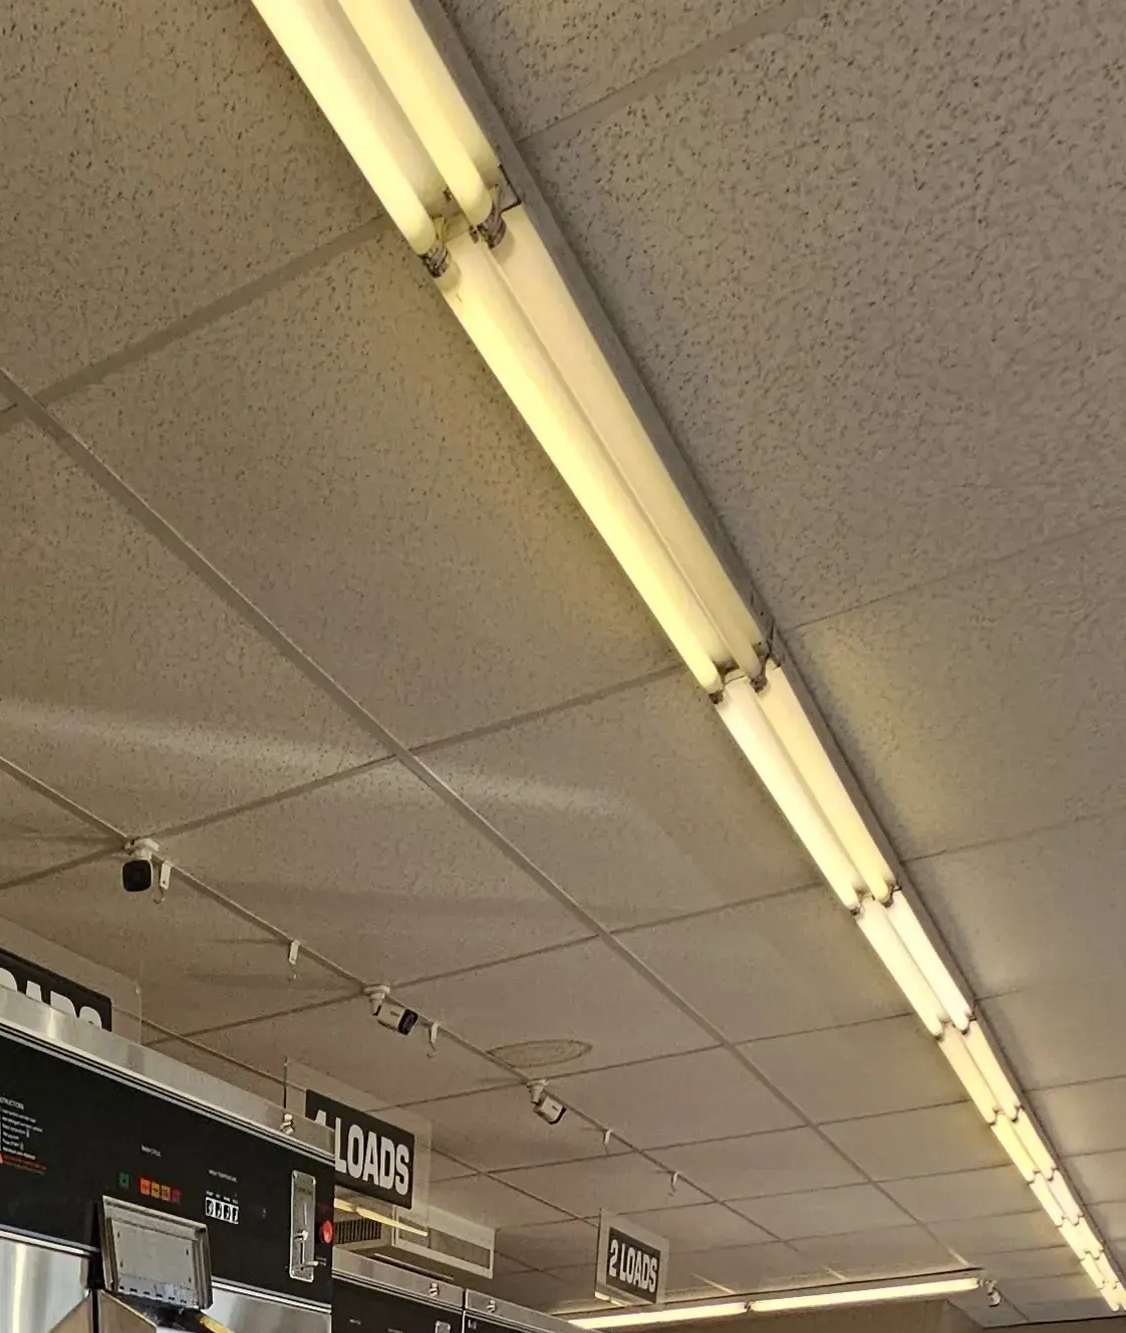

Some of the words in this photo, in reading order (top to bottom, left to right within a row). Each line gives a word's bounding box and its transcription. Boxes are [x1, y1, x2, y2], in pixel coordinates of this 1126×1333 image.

[334, 1117, 410, 1195] LOADS
[609, 1239, 619, 1278] 2
[619, 1243, 658, 1293] LOADS
